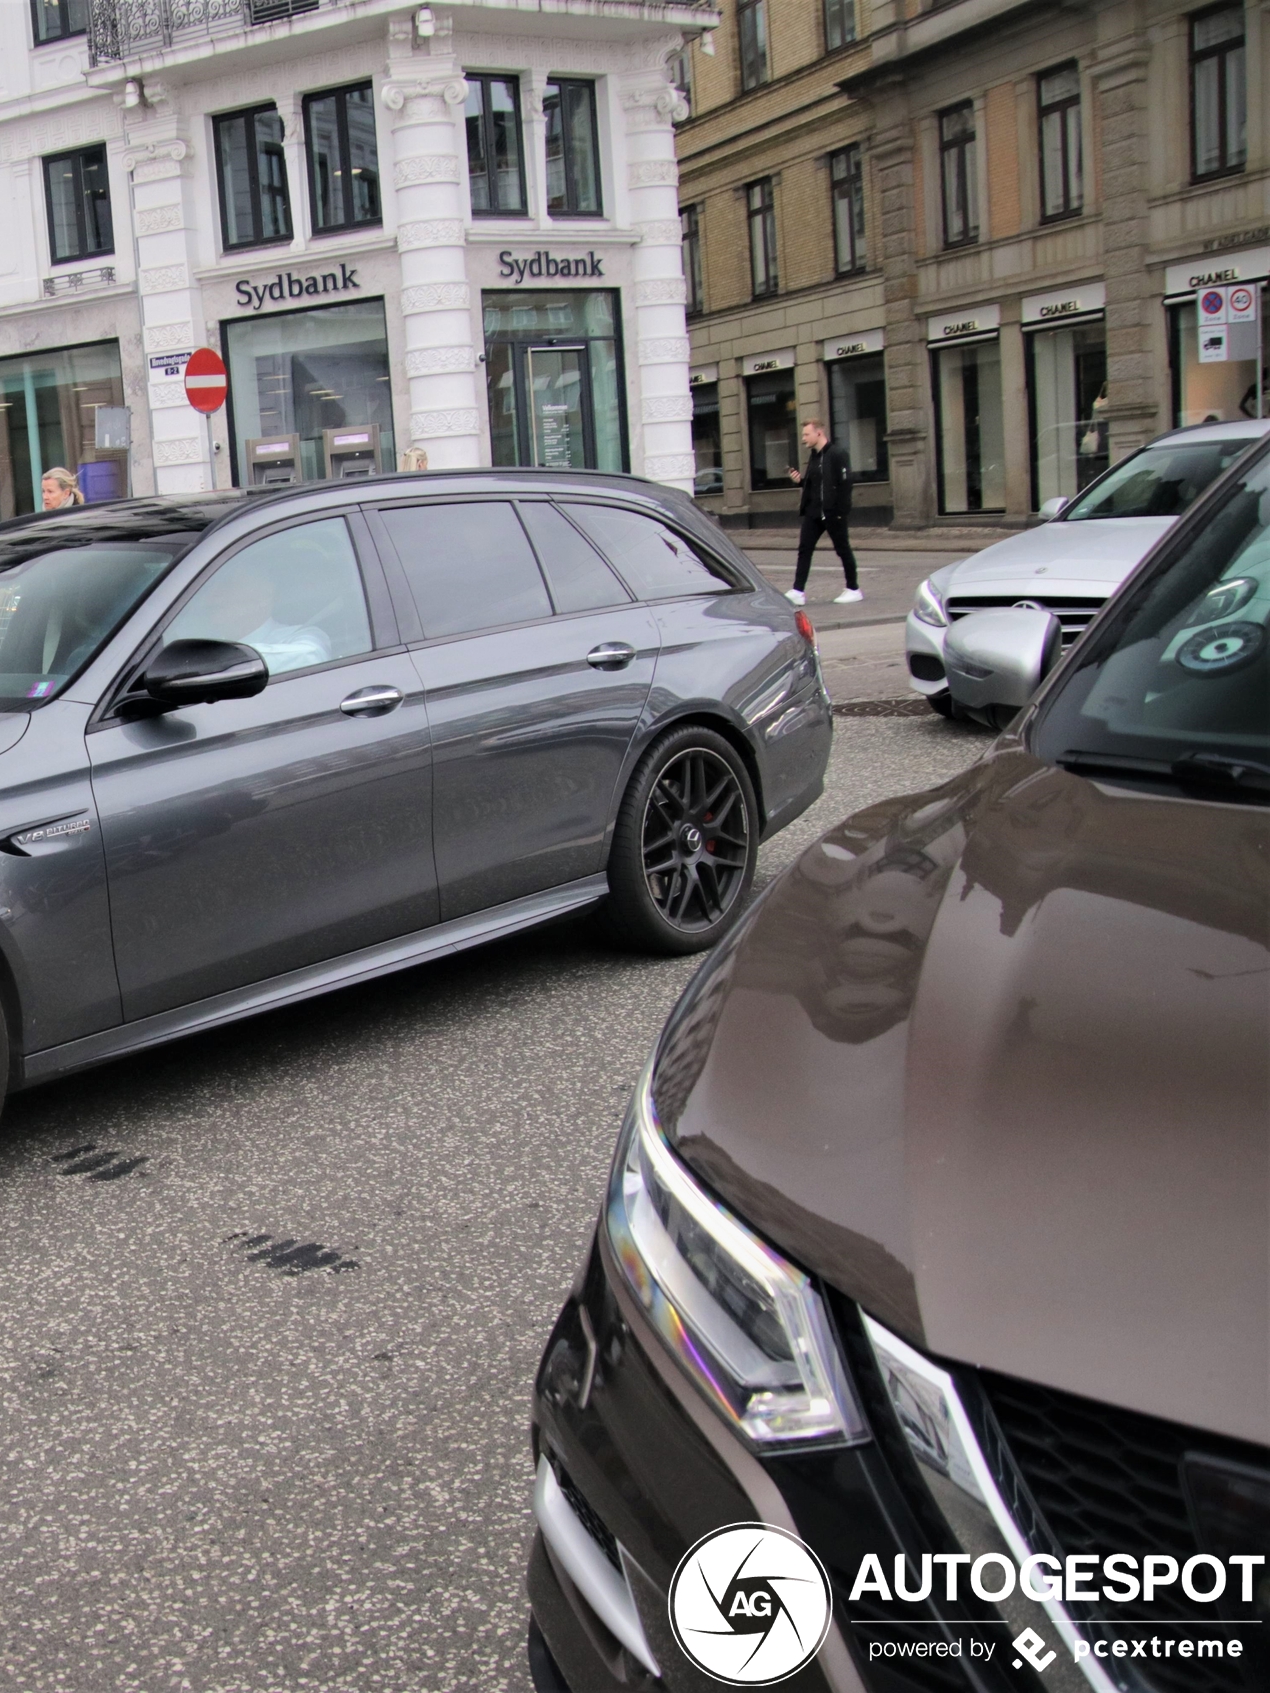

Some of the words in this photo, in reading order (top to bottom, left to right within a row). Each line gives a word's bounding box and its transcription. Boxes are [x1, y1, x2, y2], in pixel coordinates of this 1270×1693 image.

[499, 251, 605, 284] Sydbank
[235, 263, 360, 310] Sydbank
[1189, 268, 1238, 288] CHANEL
[1233, 294, 1248, 305] 40
[1040, 300, 1079, 317] CHANEL
[943, 320, 978, 335] CHANEL
[836, 343, 866, 356] CHANEL
[753, 360, 779, 371] CHANEL
[17, 830, 44, 845] V8
[46, 819, 90, 835] BITURBO
